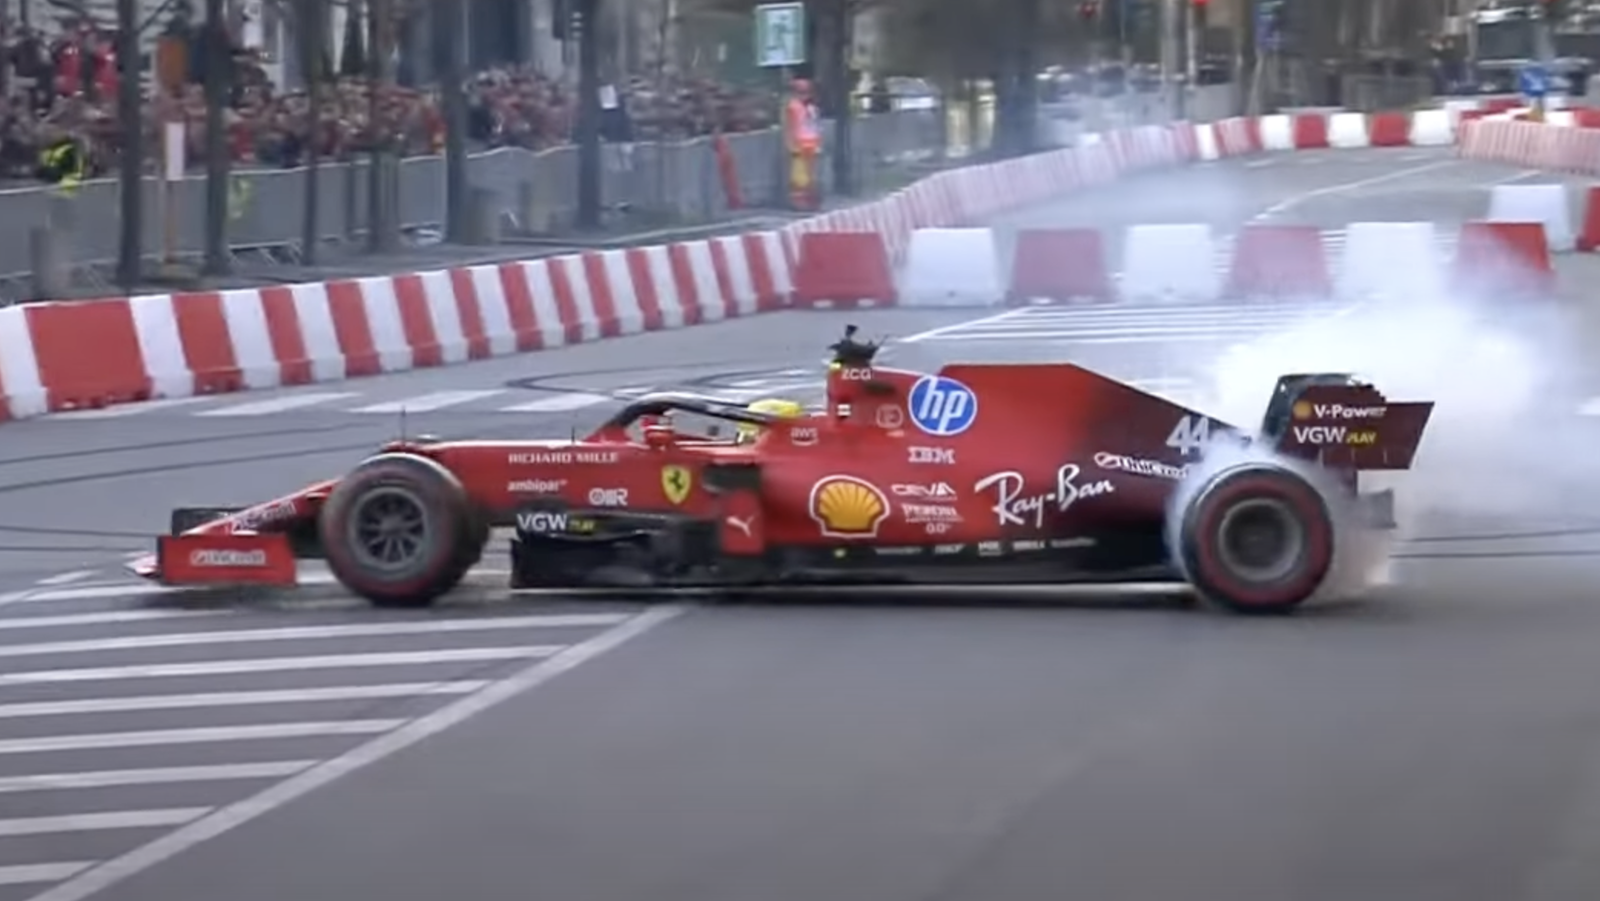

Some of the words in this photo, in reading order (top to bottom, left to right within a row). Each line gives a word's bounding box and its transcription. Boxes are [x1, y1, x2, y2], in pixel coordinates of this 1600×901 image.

[918, 376, 969, 433] hp
[1165, 415, 1209, 456] 44
[1294, 426, 1346, 443] VGW
[508, 452, 572, 464] RICHARD
[575, 452, 619, 464] MILLE
[907, 446, 956, 464] IBM
[974, 464, 1115, 528] Ray-Ban
[517, 513, 567, 531] VGW
